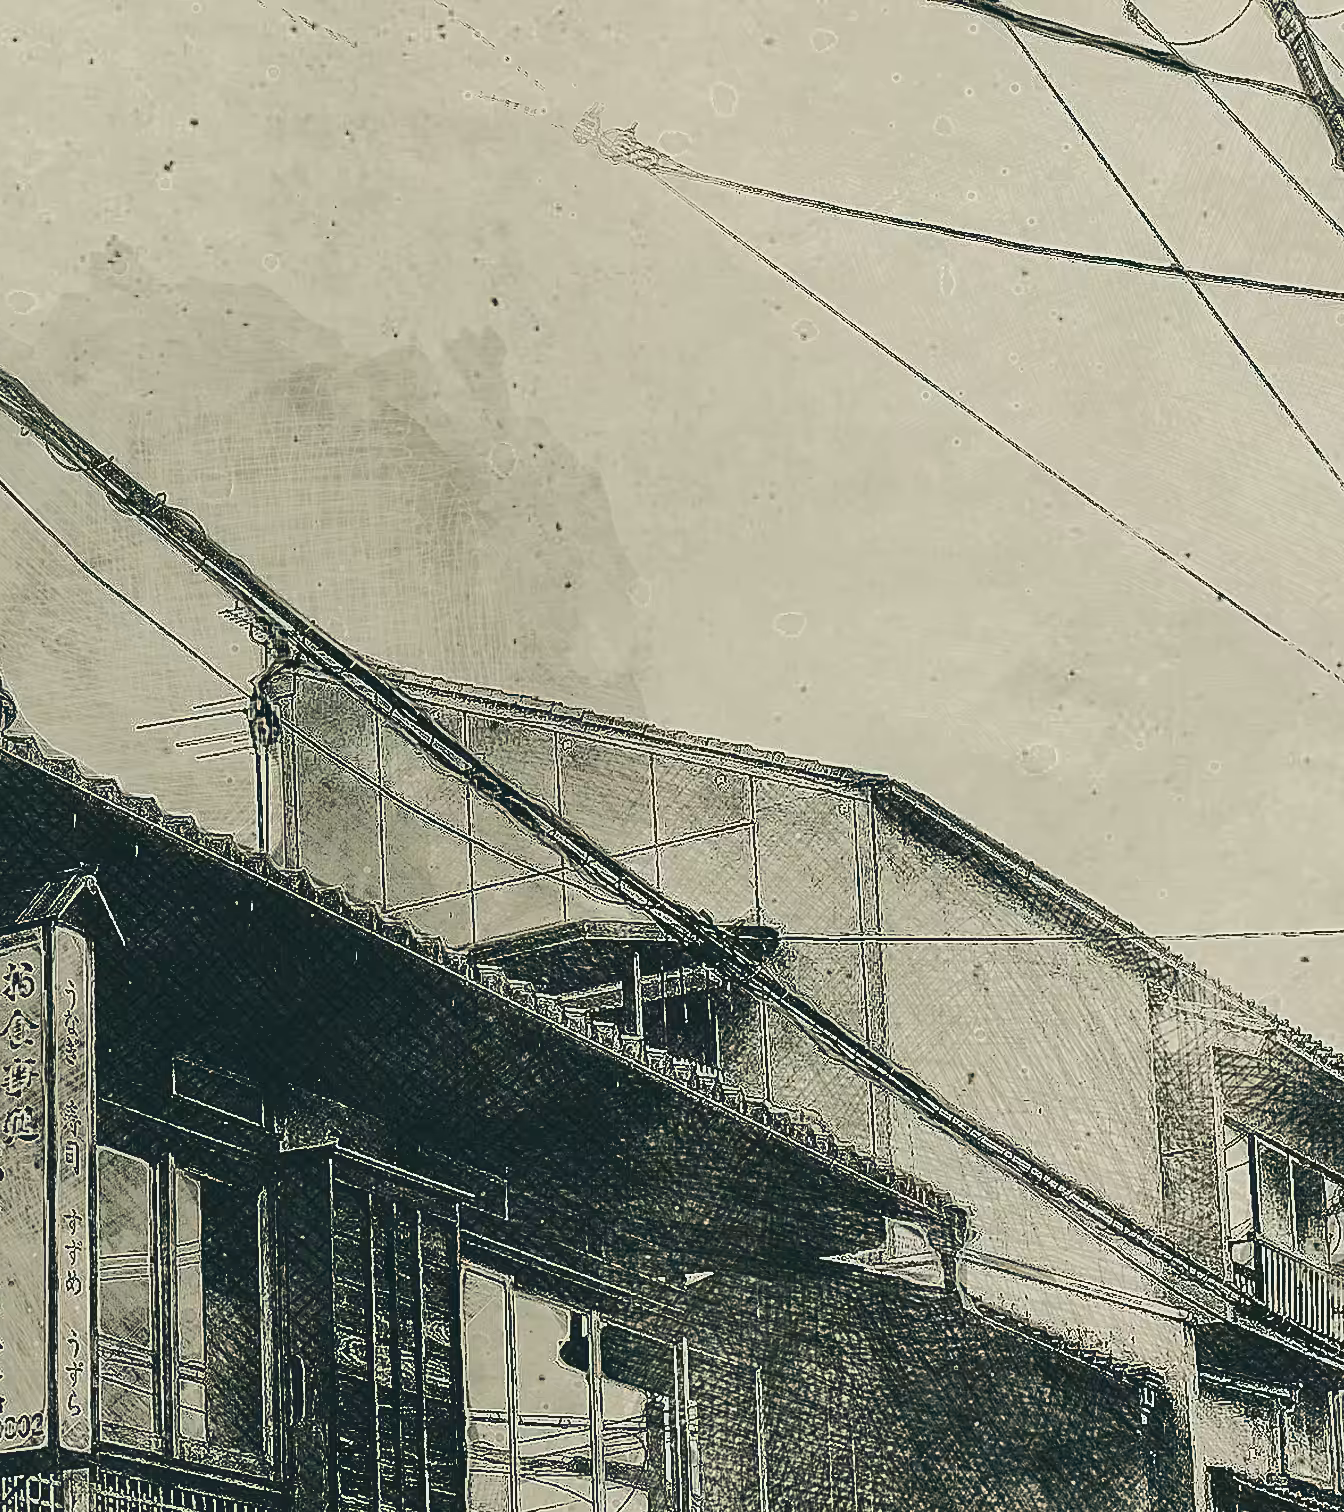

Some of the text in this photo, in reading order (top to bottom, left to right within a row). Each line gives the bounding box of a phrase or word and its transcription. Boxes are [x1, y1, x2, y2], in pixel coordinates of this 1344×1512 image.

[63, 1208, 83, 1297] すずめ
[64, 1329, 83, 1417] うずら
